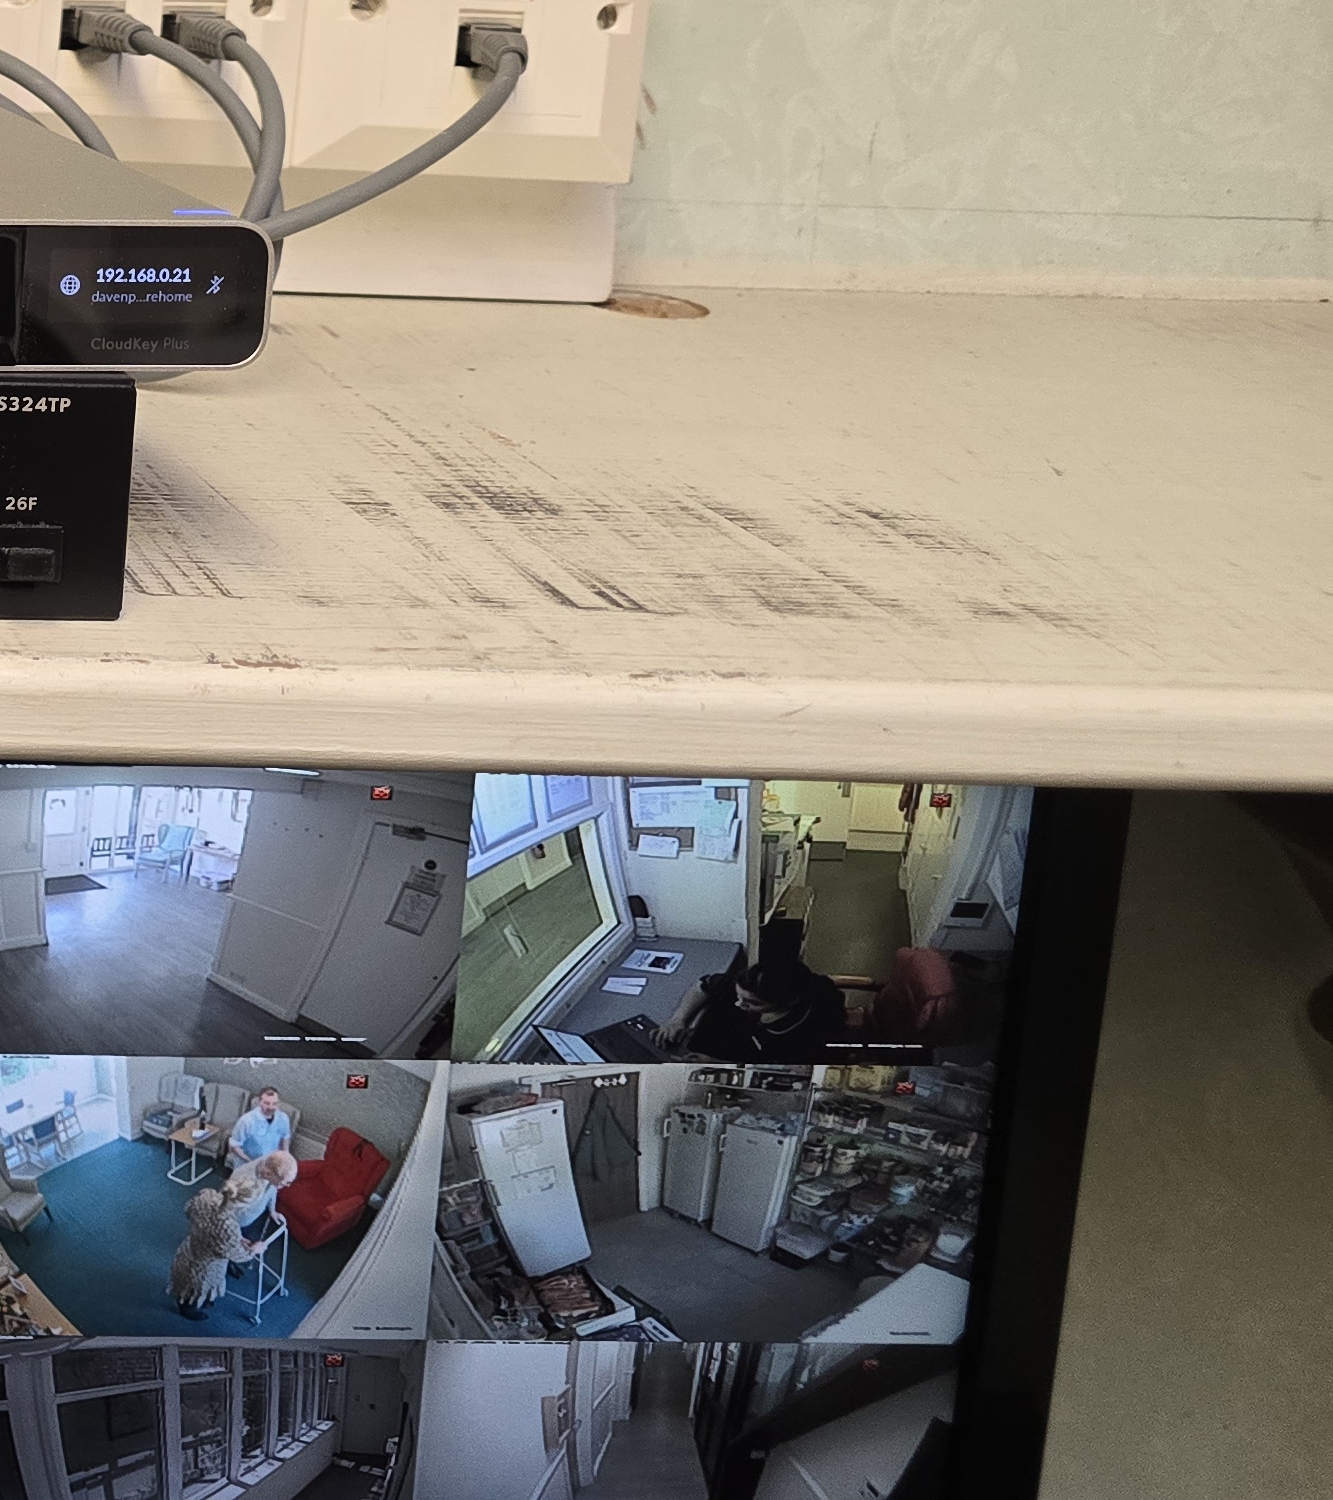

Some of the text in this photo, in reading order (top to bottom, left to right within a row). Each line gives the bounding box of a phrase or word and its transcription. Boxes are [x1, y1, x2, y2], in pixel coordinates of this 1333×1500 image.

[96, 267, 192, 283] 192.168.0.21
[91, 290, 193, 304] davenp...rehome
[163, 337, 190, 350] Plus
[5, 496, 38, 511] 26F
